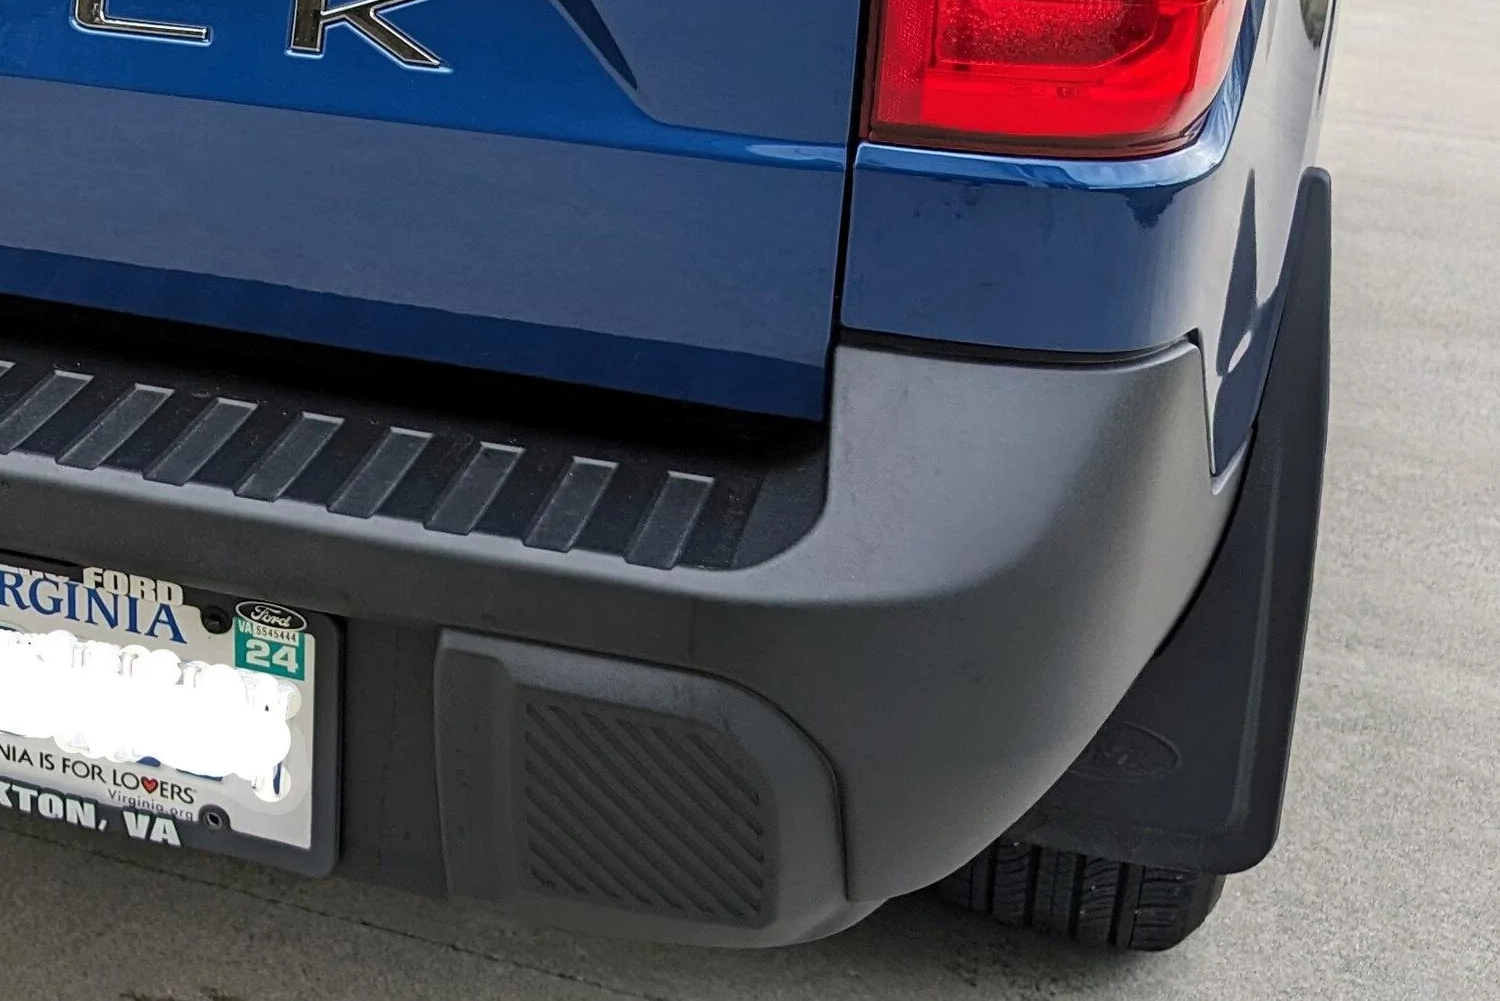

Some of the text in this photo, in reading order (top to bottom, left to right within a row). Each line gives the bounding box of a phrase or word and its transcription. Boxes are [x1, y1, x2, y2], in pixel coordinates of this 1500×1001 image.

[83, 566, 184, 606] FORD
[237, 619, 253, 635] VA
[246, 639, 299, 673] 24
[40, 752, 55, 771] IS
[62, 757, 107, 784] FOR
[108, 788, 194, 822] Virginia.org
[123, 810, 181, 847] VA
